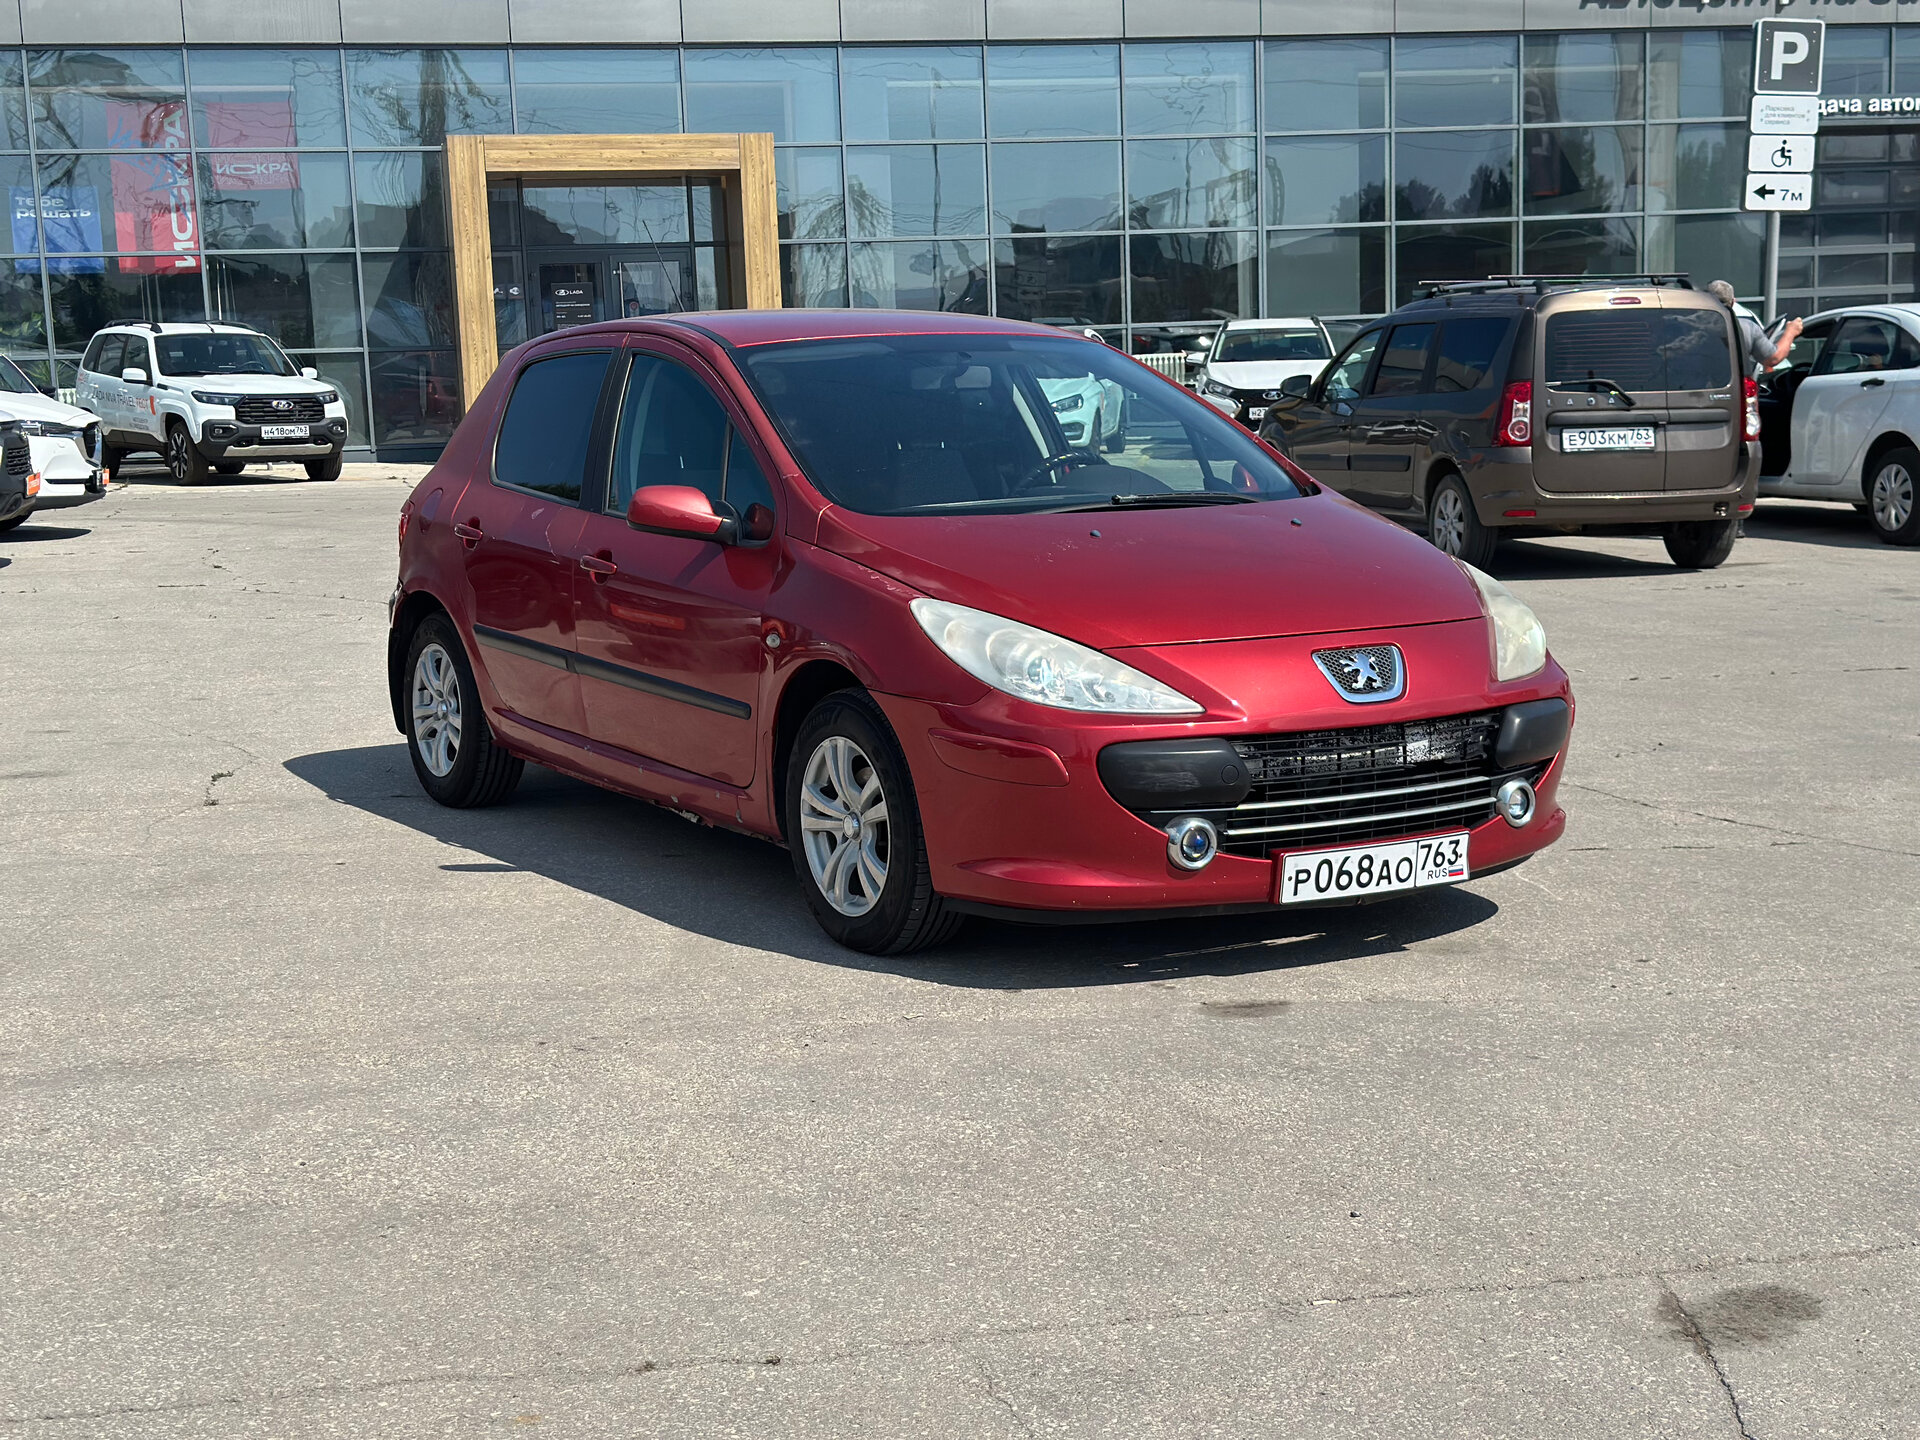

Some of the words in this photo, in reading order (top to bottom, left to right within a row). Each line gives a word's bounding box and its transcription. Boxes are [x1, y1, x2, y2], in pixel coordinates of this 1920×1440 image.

[1771, 31, 1809, 80] P
[216, 162, 294, 175] ИСКРА
[15, 196, 64, 207] тебе
[1568, 429, 1627, 446] Е903КМ
[1629, 428, 1650, 441] 763
[1292, 853, 1414, 897] Р068АО
[1419, 839, 1460, 871] 763
[1427, 867, 1448, 880] RUS
